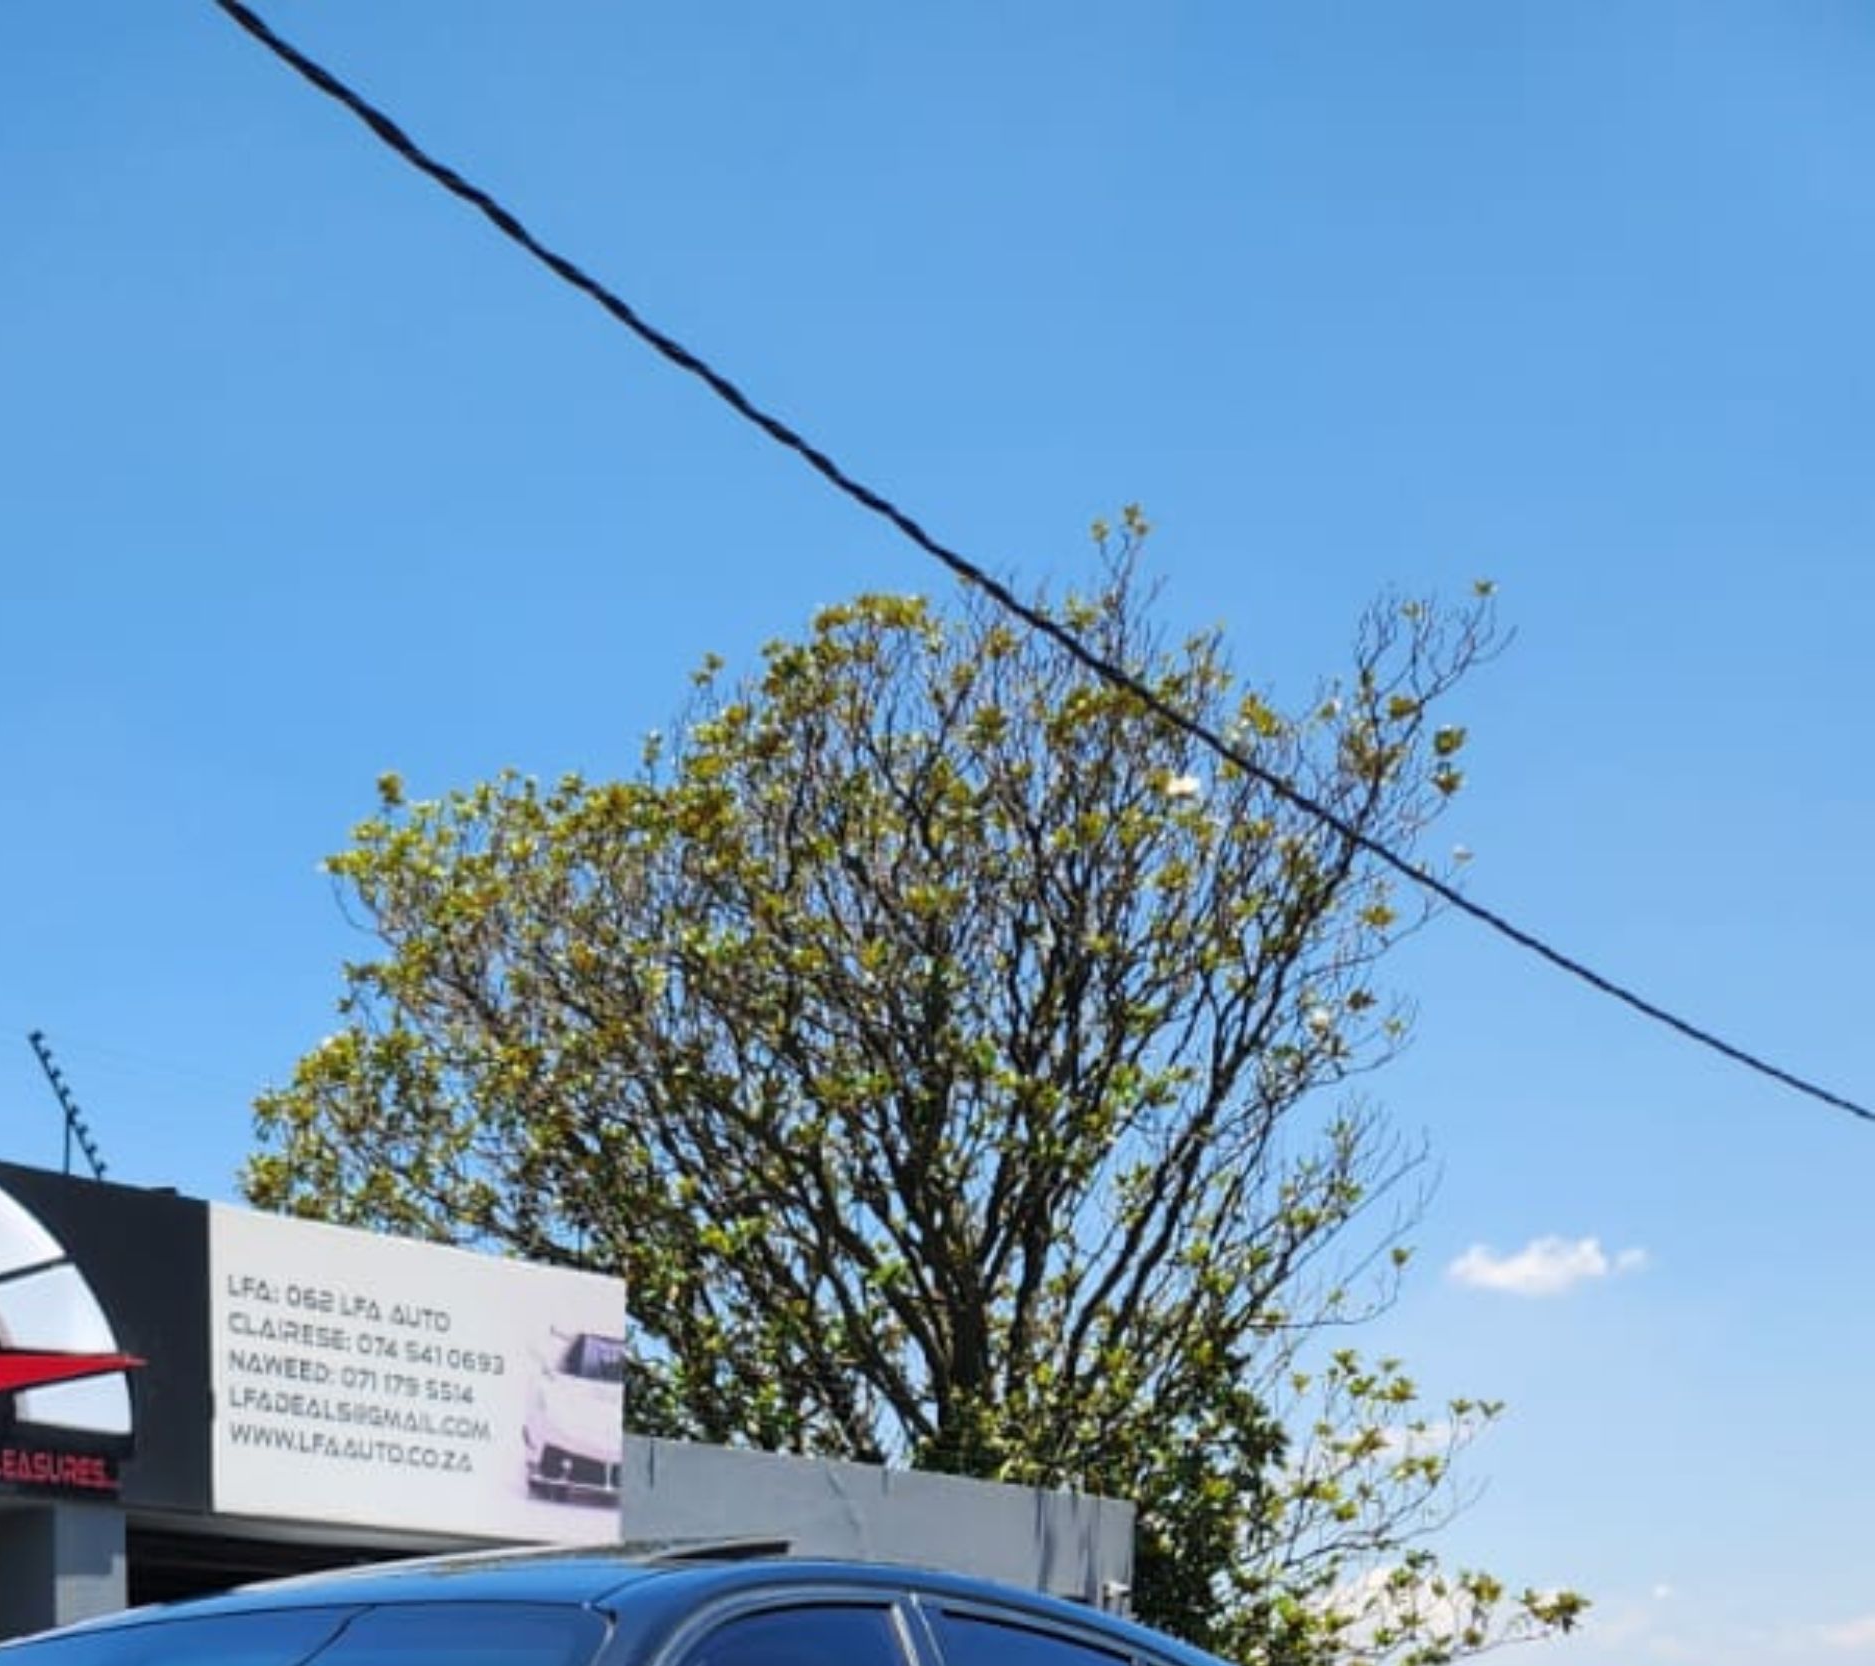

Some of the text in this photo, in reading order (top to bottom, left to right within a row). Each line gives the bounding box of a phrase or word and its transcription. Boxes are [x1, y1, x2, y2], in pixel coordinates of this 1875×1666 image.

[228, 1274, 451, 1333] LFA: 062 LFA AUTO
[357, 1333, 398, 1358] 074
[341, 1366, 377, 1391] 071
